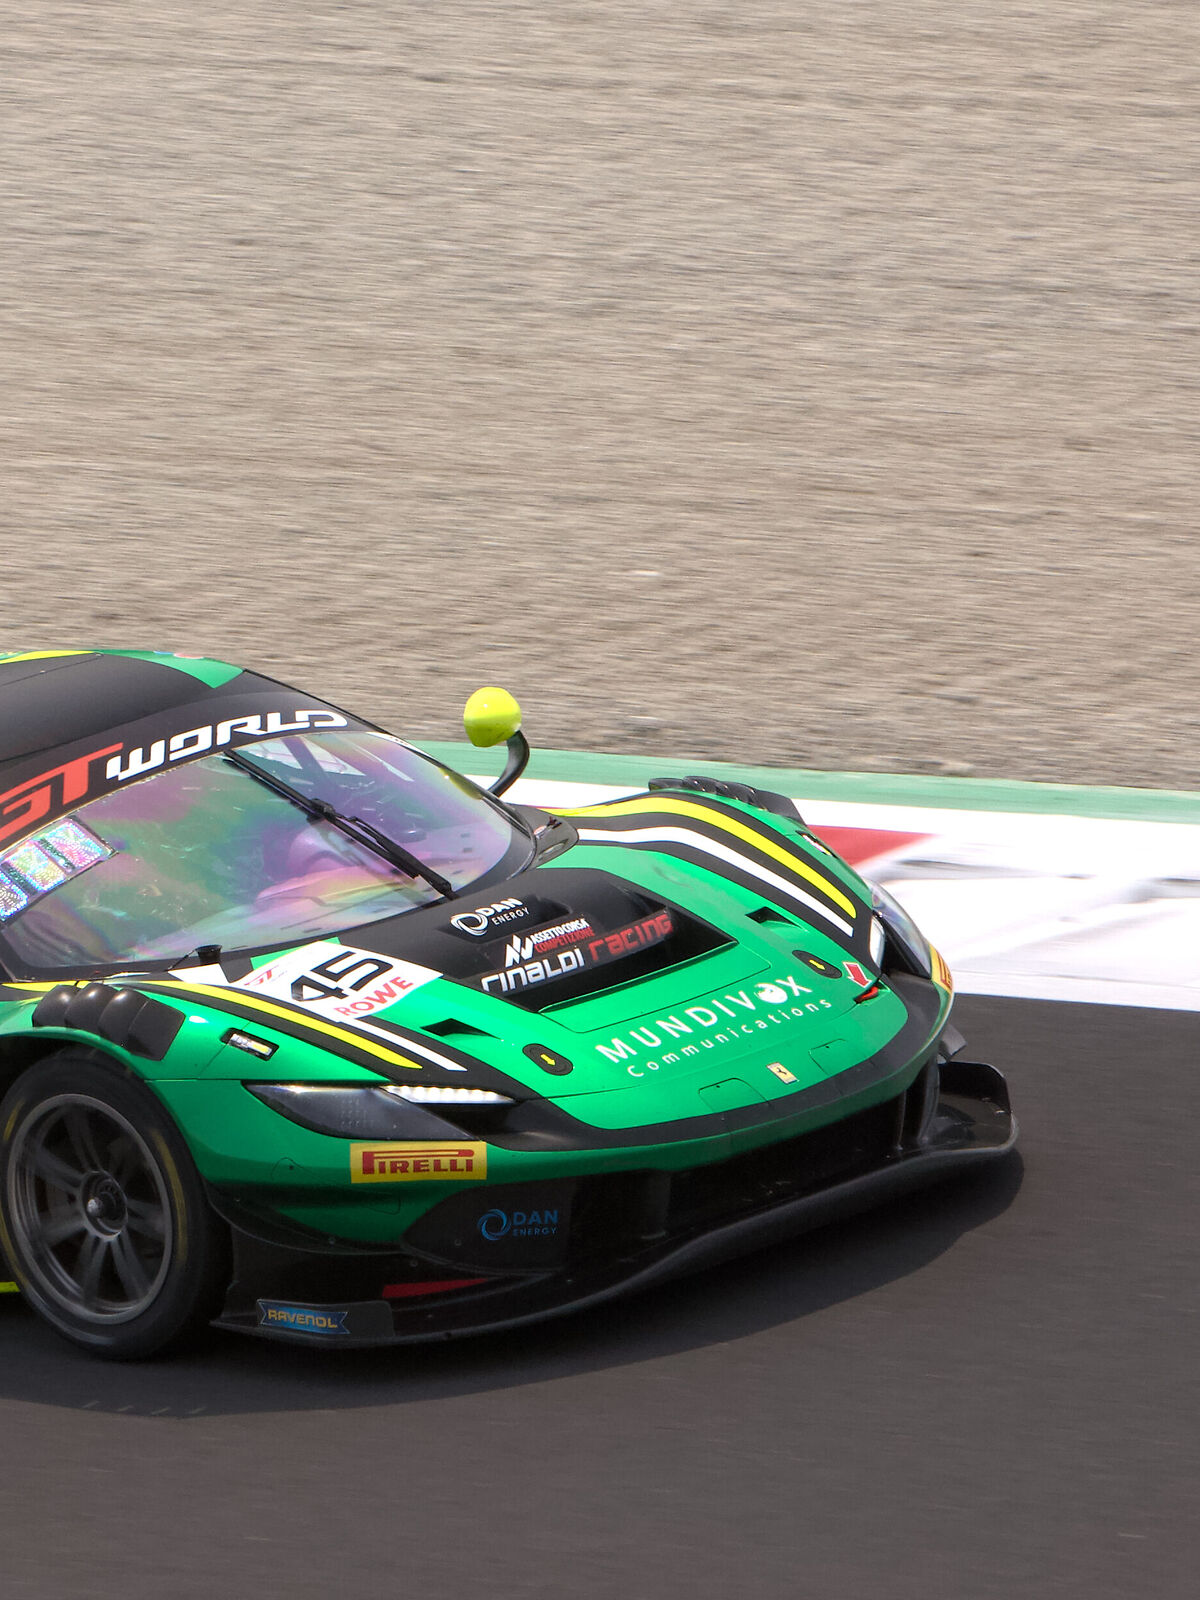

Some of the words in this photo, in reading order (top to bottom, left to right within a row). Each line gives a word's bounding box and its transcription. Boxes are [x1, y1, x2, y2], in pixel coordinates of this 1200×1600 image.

[106, 710, 348, 781] WORLD
[475, 897, 523, 917] DAN
[491, 907, 530, 926] ENERGY
[534, 926, 596, 954] COMPETIZIONE
[291, 951, 394, 1002] 45
[334, 976, 414, 1016] ROWE
[595, 976, 813, 1063] MUNDIVOX
[627, 999, 832, 1077] Communications
[362, 1149, 475, 1175] PIRELLI
[513, 1209, 559, 1226] DAN
[512, 1227, 558, 1238] ENERGY
[267, 1309, 339, 1329] RAVENOL
